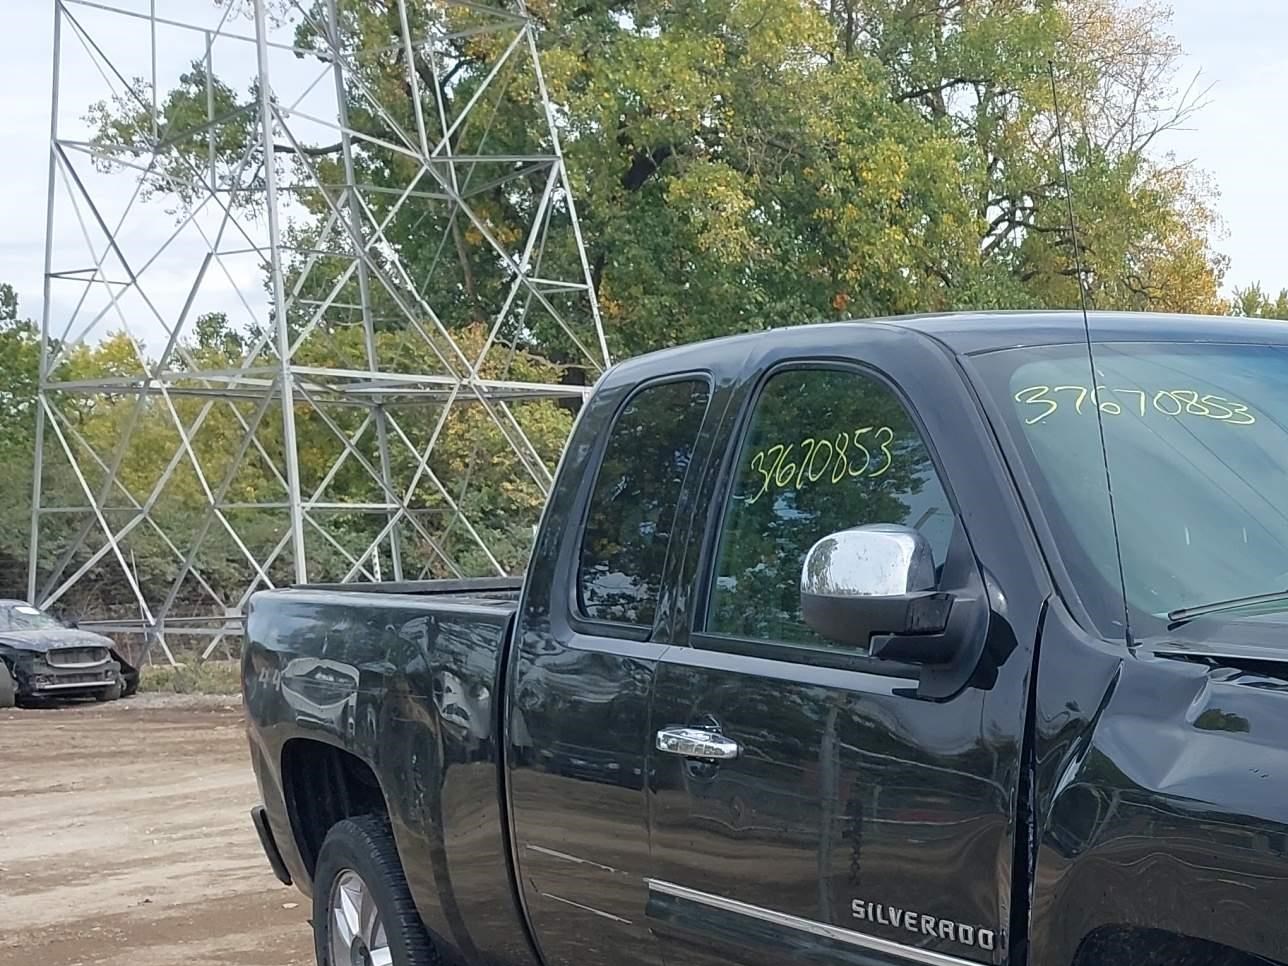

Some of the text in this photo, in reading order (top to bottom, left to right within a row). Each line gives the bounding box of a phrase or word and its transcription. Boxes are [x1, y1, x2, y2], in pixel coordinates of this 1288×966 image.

[1014, 385, 1256, 425] 37670853
[750, 426, 894, 504] 37670853
[851, 899, 995, 950] SILVERADO
